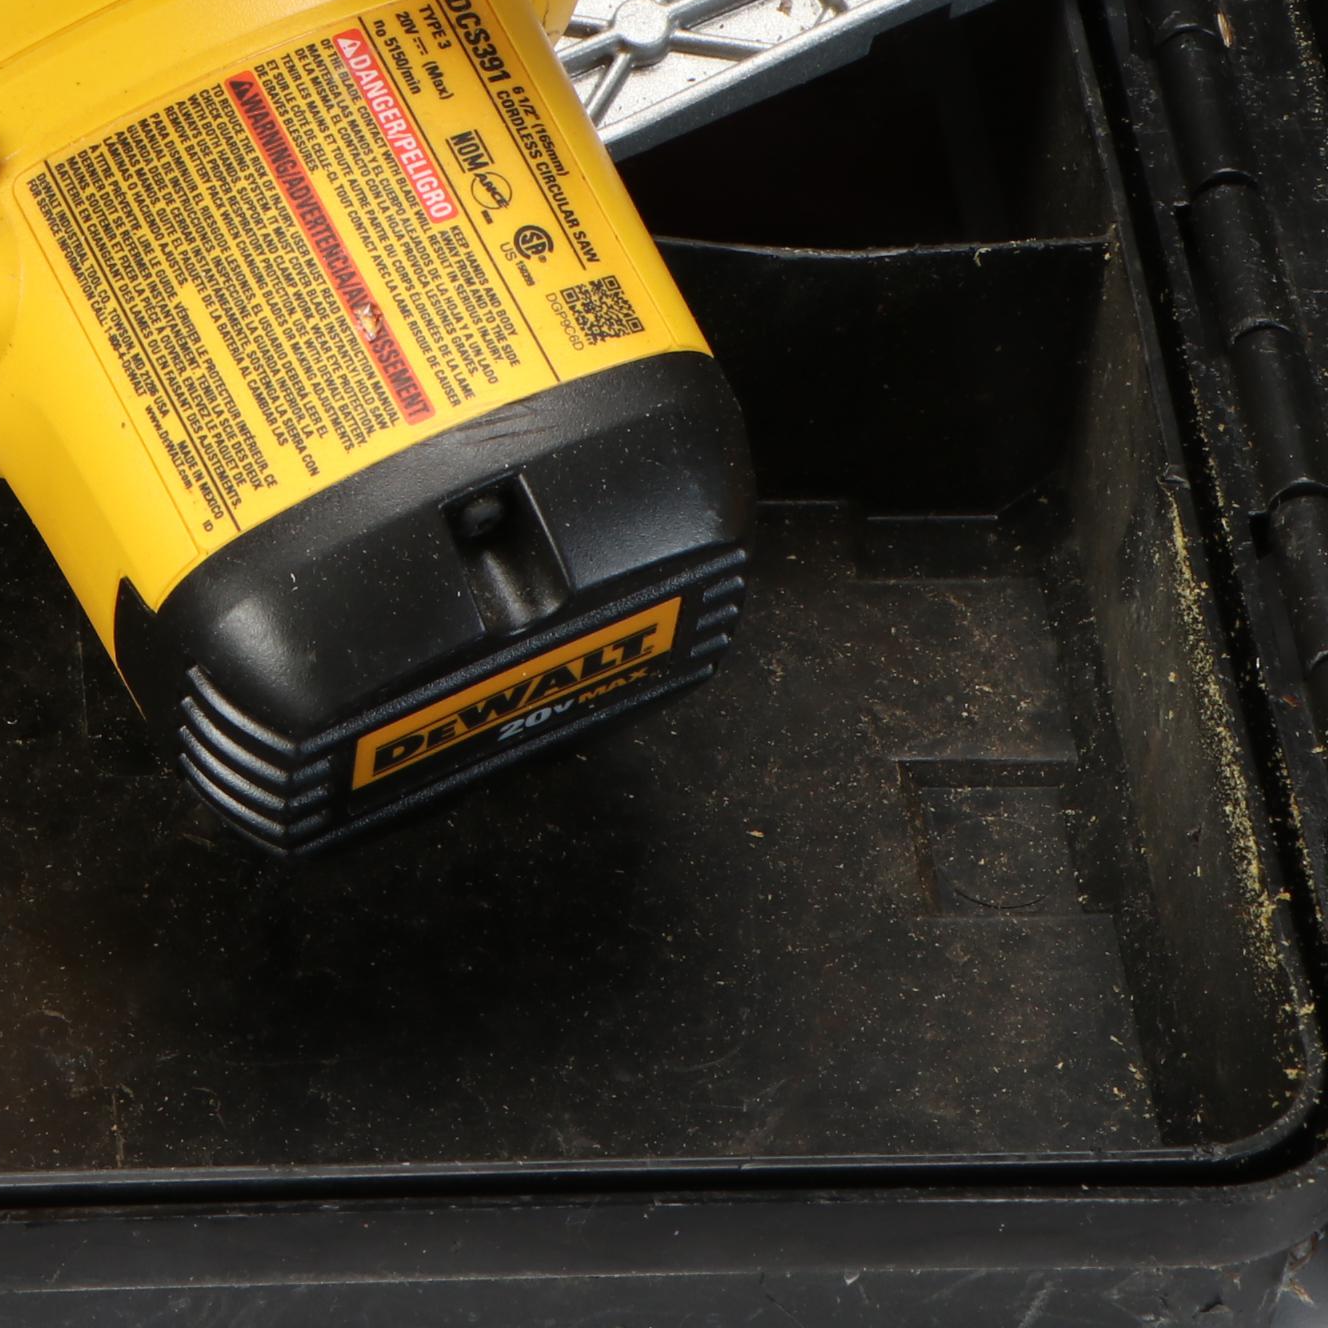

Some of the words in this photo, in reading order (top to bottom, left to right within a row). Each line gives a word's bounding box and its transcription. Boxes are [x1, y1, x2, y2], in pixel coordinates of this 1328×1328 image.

[319, 38, 334, 50] OF
[418, 3, 446, 39] TYPE
[437, 39, 452, 49] 3
[327, 50, 344, 71] THE
[383, 36, 421, 94] 5150/min
[394, 10, 419, 34] 20V
[421, 60, 454, 99] (Max)
[198, 89, 223, 122] CHECK
[356, 105, 388, 148] CONTACT
[216, 121, 250, 172] GUARDING
[344, 52, 455, 221] DANGER/PELIGRO
[449, 130, 489, 172] NOM
[511, 85, 525, 94] 6
[530, 123, 570, 176] (165mm)
[381, 149, 402, 176] WITH
[496, 90, 543, 159] CORDLESS
[535, 161, 580, 228] CIRCULAR
[572, 230, 600, 262] SAW
[395, 176, 420, 209] BLADE
[174, 100, 203, 139] ALWAYS
[195, 137, 213, 159] USE
[205, 157, 233, 196] PROPER
[225, 194, 267, 256] RESPIRATORY
[291, 317, 310, 339] USE
[302, 336, 323, 365] WITH
[187, 93, 208, 122] WITH
[200, 120, 223, 149] BOTH
[235, 186, 267, 231] SUPPORT
[259, 232, 279, 254] AND
[272, 254, 298, 288] CLAMP
[309, 322, 332, 354] WEAR
[325, 353, 343, 374] EYE
[210, 82, 224, 98] TO
[217, 97, 246, 136] REDUCE
[236, 134, 256, 156] THE
[248, 155, 269, 180] RISK
[261, 179, 276, 192] OF
[289, 230, 310, 258] USER
[303, 256, 327, 286] MUST
[319, 286, 341, 314] READ
[334, 314, 377, 380] INSTRUCTION
[266, 214, 280, 225] IT
[271, 225, 295, 255] MUST
[413, 208, 432, 234] WILL
[163, 104, 191, 145] REMOVE
[183, 143, 213, 184] BATTERY
[205, 183, 226, 211] PACK
[219, 208, 242, 240] WHEN
[235, 239, 268, 290] CHANGING
[261, 289, 288, 327] BLADES
[281, 326, 296, 342] OR
[289, 340, 317, 381] MAKING
[236, 91, 432, 421] WARNING/ADVERTENCIA/AVISSEMENT
[426, 233, 454, 269] RESULT
[499, 241, 517, 261] US
[287, 255, 312, 289] COVER
[445, 270, 460, 283] IN
[448, 224, 470, 249] KEEP
[463, 249, 489, 285] HANDS
[482, 286, 501, 307] AND
[495, 308, 518, 336] BODY
[305, 287, 330, 322] BLADE
[437, 230, 461, 257] AWAY
[453, 258, 476, 287] FROM
[468, 288, 488, 309] AND
[482, 308, 496, 323] TO
[489, 323, 508, 344] THE
[500, 343, 520, 367] SIDE
[452, 282, 483, 325] SERIOUS
[353, 377, 375, 405] HOLD
[368, 405, 389, 430] SAW
[578, 667, 649, 704] MAX
